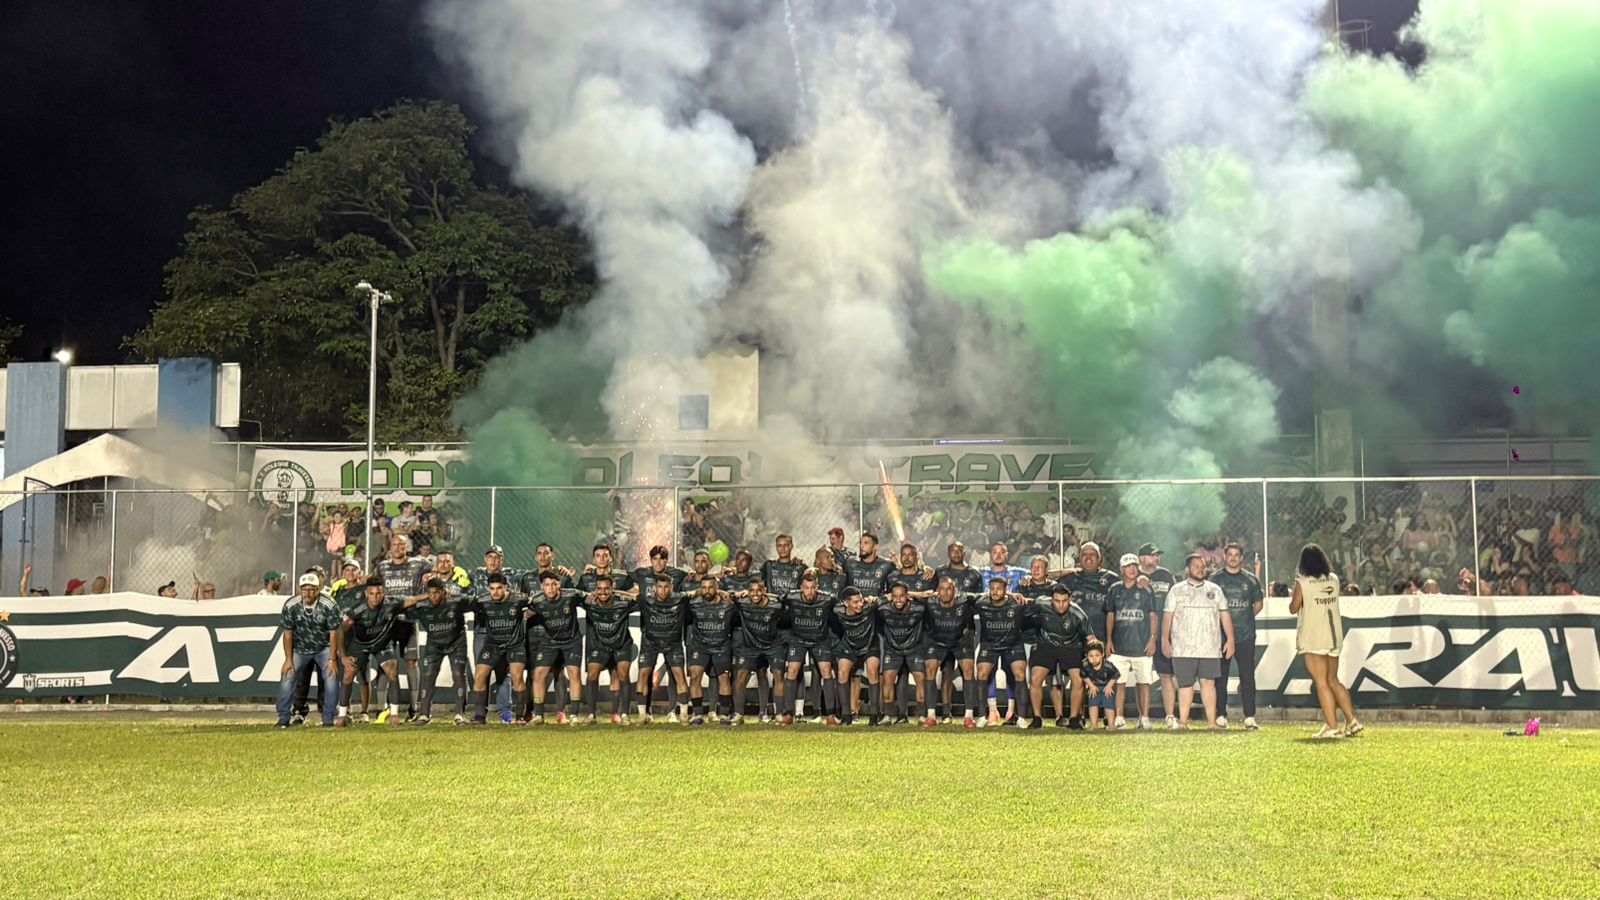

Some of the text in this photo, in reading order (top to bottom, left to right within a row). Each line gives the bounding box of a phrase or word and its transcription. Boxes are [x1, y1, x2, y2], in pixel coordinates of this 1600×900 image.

[385, 578, 413, 588] Daniel
[489, 619, 517, 628] Daniel
[697, 621, 725, 630] Daniel
[37, 678, 84, 688] SPORTS
